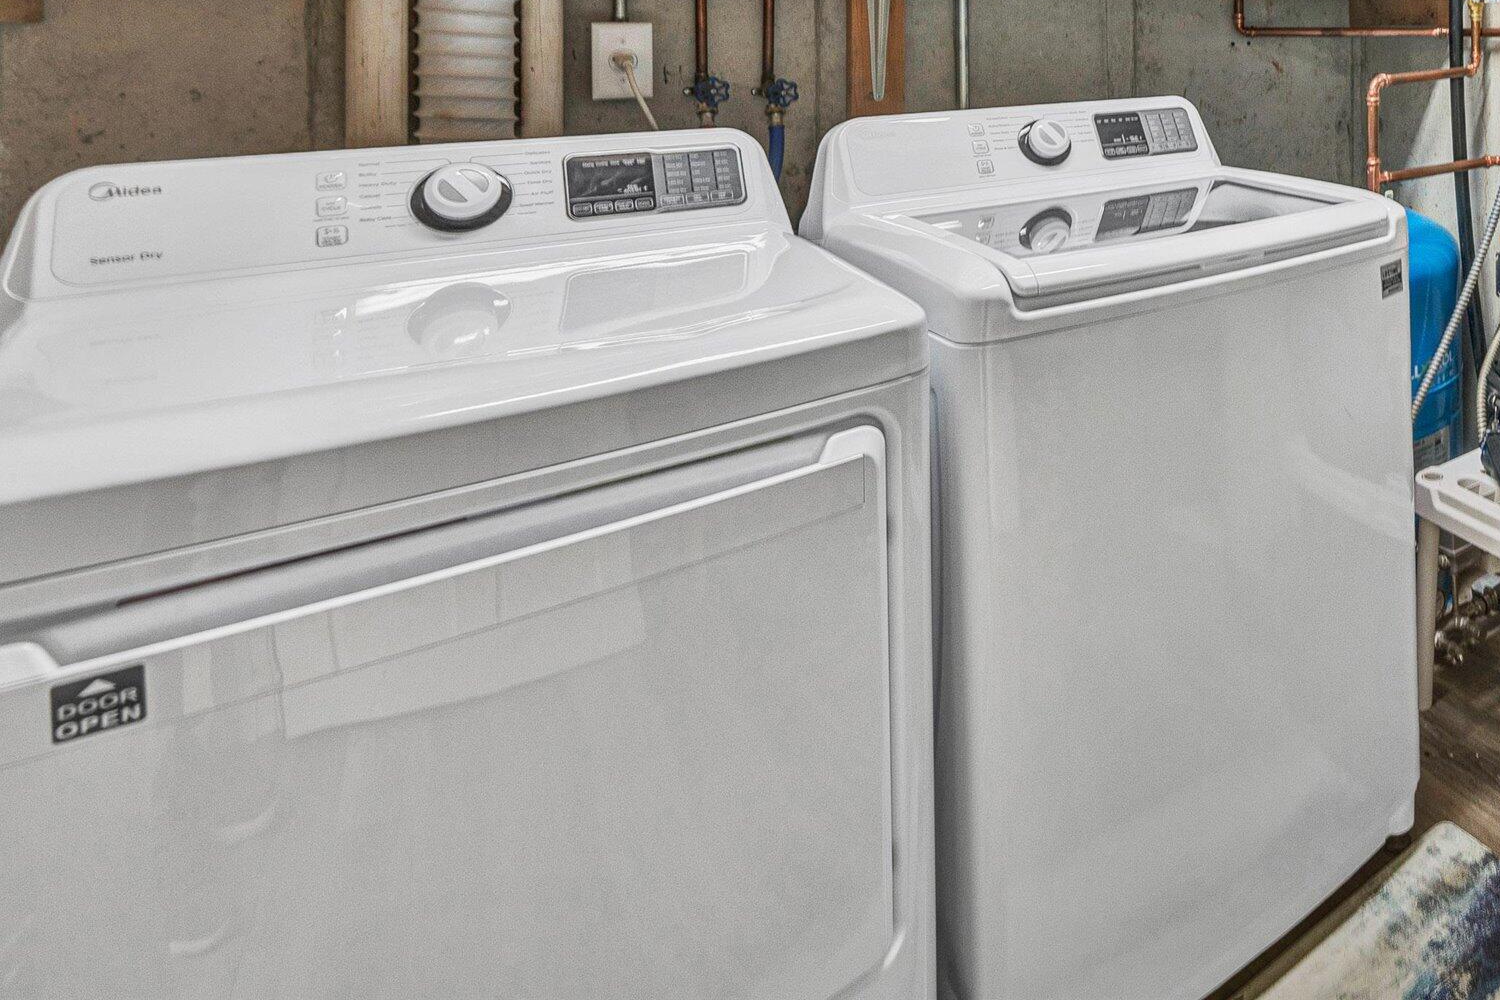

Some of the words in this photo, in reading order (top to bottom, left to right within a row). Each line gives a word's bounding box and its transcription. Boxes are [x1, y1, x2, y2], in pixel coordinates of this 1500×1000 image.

[88, 180, 162, 201] Midea
[55, 703, 141, 741] OPEN
[57, 686, 138, 722] DOOR
